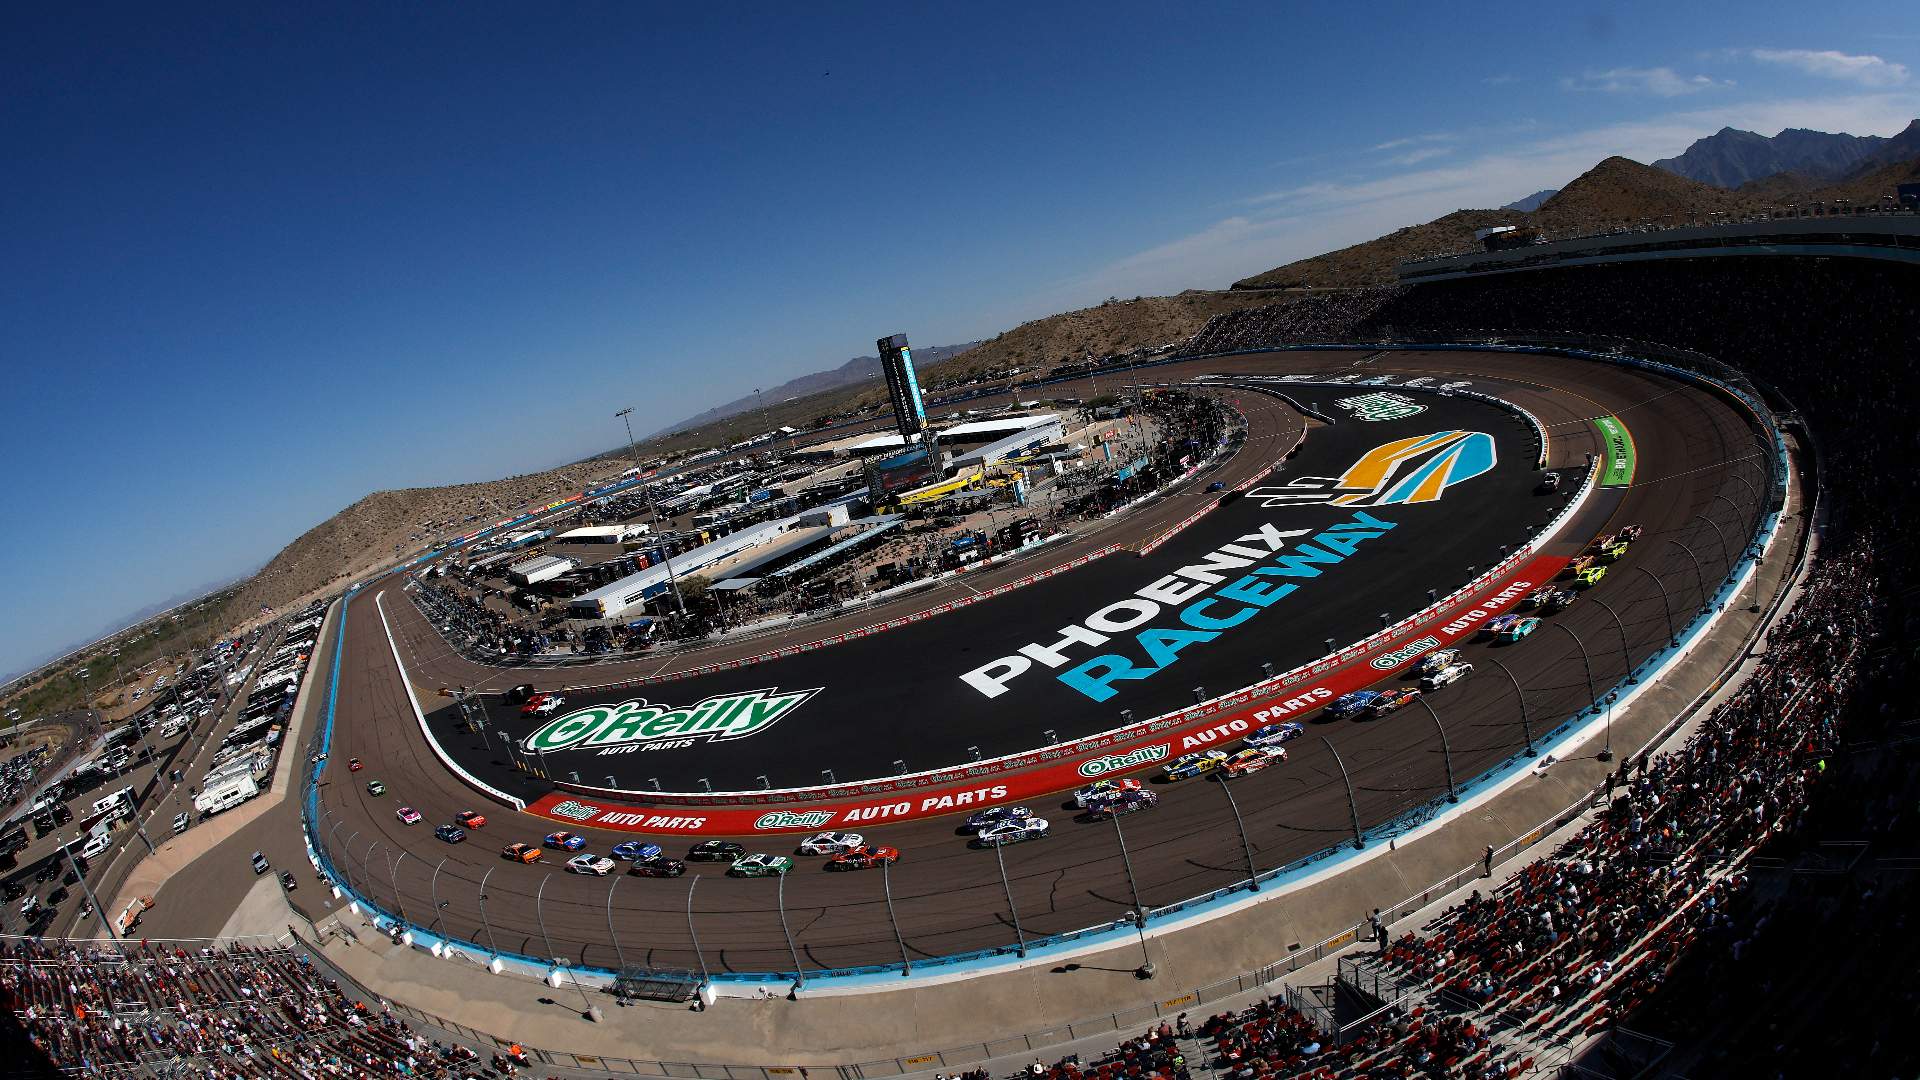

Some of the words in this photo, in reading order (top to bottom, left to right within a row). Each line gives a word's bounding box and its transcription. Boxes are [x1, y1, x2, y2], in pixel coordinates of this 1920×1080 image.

[959, 523, 1312, 698] PHOENIX
[1056, 512, 1397, 702] RACEWAY
[1370, 636, 1441, 670] O'Reilly
[1444, 609, 1488, 635] AUTO
[1486, 581, 1532, 608] PARTS
[530, 693, 802, 750] O'Reilly
[597, 744, 641, 755] AUTO
[642, 738, 695, 752] PARTS
[1077, 743, 1170, 778] O'Reilly
[1182, 720, 1248, 749] AUTO
[1260, 688, 1333, 722] PARTS
[1201, 761, 1212, 770] 34
[598, 812, 644, 826] AUTO
[647, 816, 706, 829] PARTS
[755, 811, 836, 829] O'Reilly
[843, 802, 910, 821] AUTO
[922, 786, 1007, 812] PARTS
